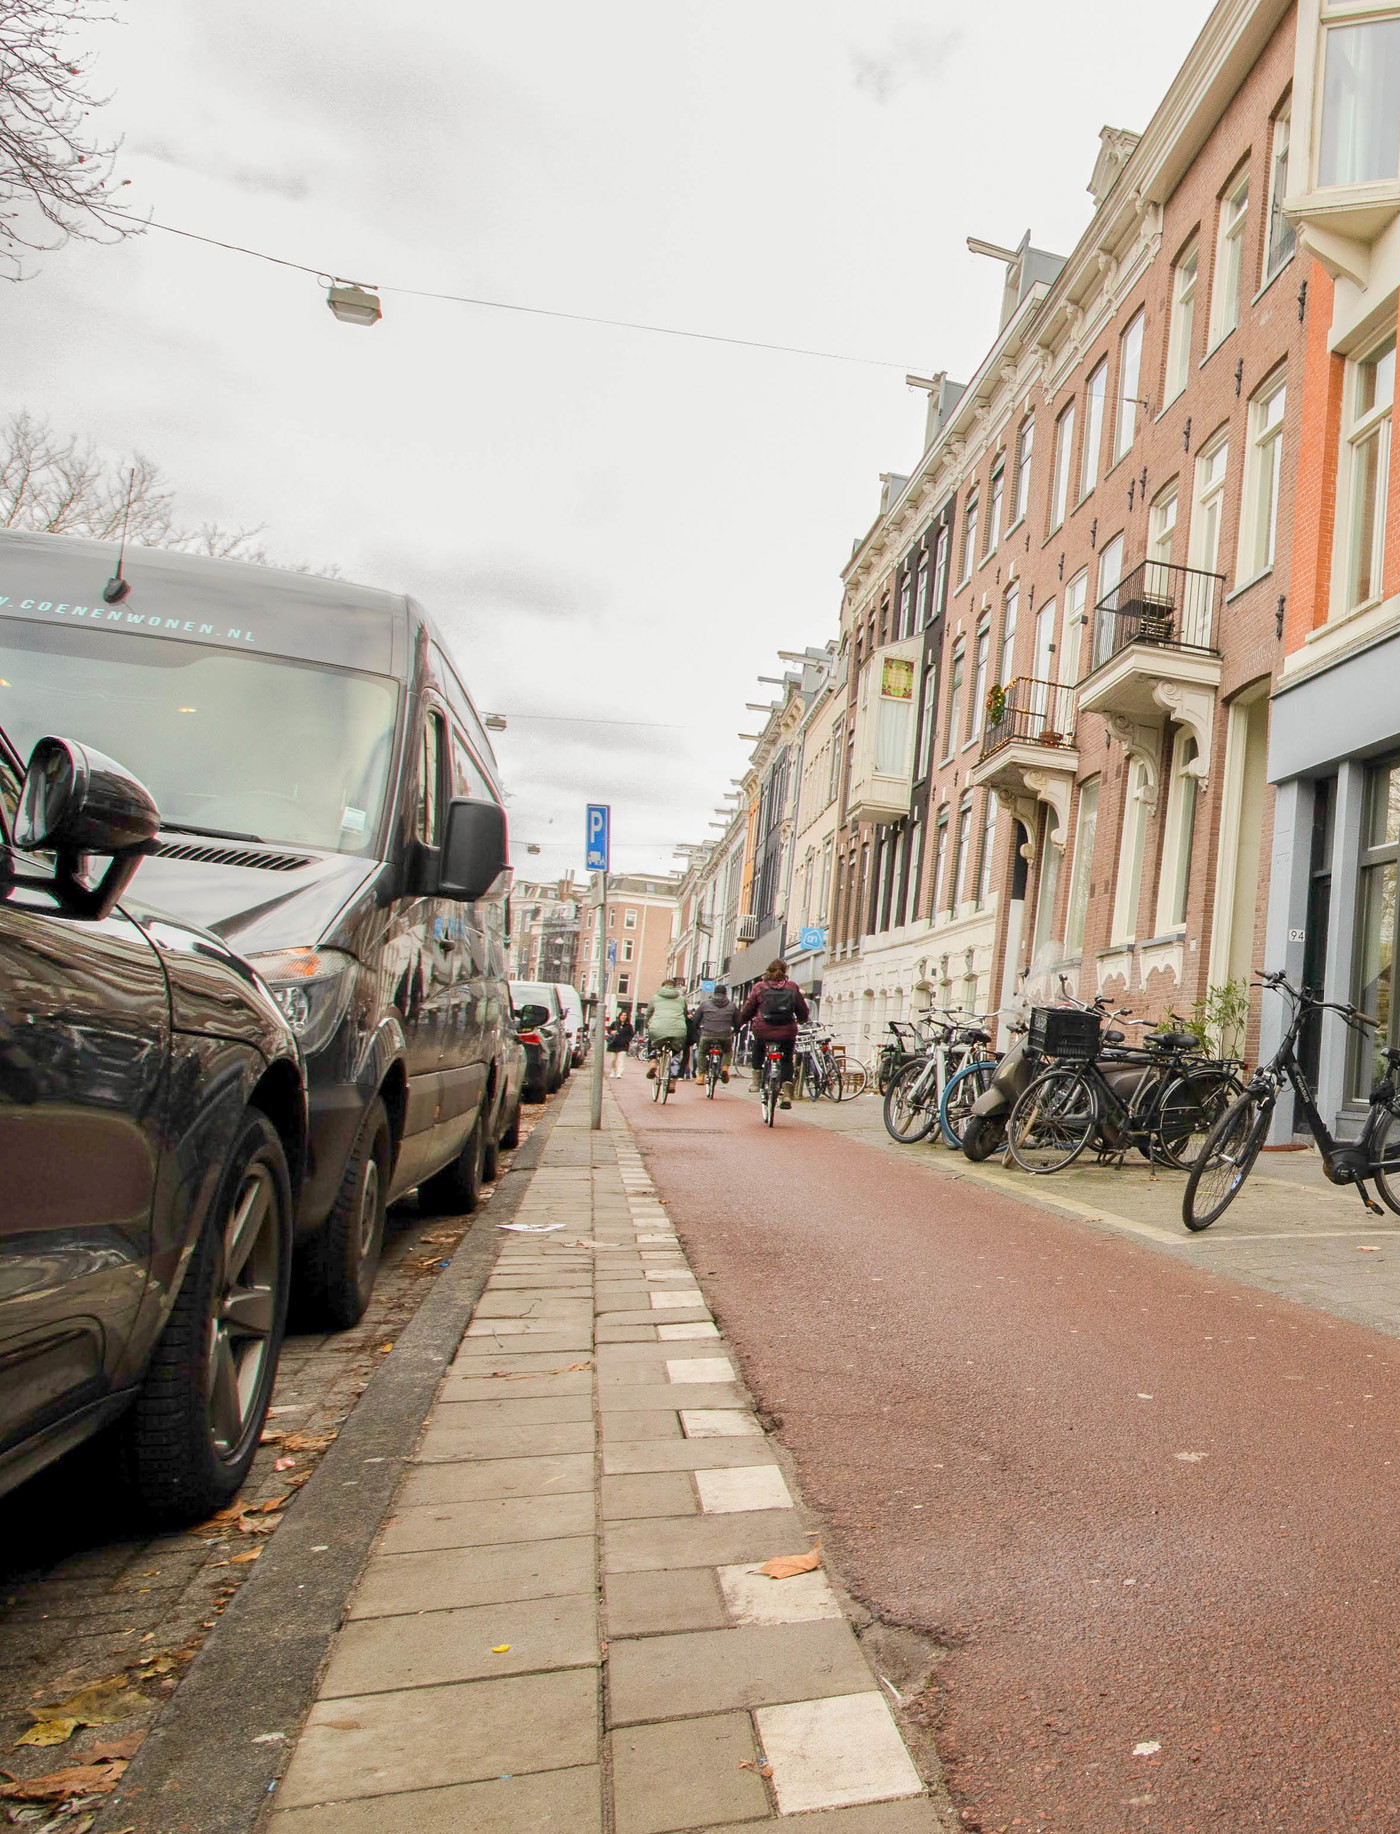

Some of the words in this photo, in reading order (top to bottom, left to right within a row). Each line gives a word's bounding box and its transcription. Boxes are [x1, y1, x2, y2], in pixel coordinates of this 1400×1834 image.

[590, 810, 603, 843] P
[1290, 930, 1304, 942] 94
[1295, 1074, 1310, 1103] PEGASUS
